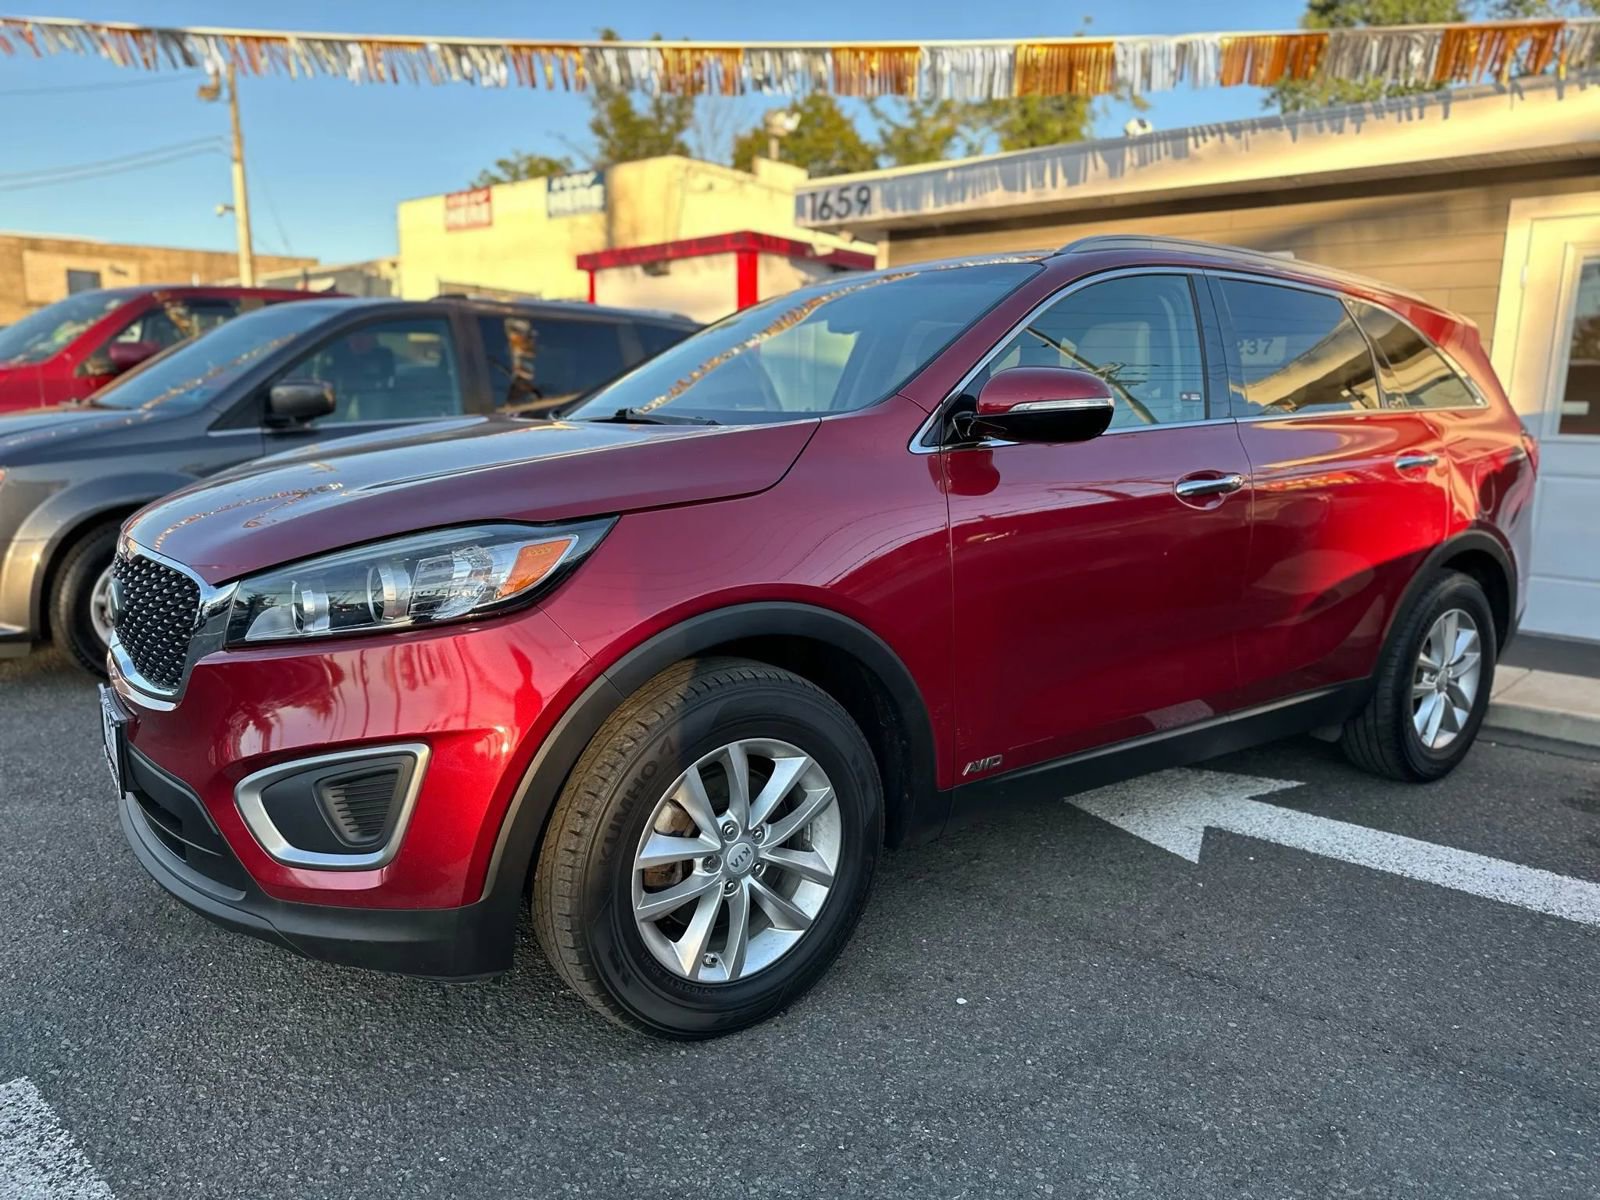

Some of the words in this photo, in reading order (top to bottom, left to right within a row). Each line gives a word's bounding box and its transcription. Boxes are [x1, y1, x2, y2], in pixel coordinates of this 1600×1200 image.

[809, 185, 871, 222] 1659
[961, 753, 1003, 777] AWD
[599, 759, 658, 866] KUMHO
[730, 846, 752, 868] KIA
